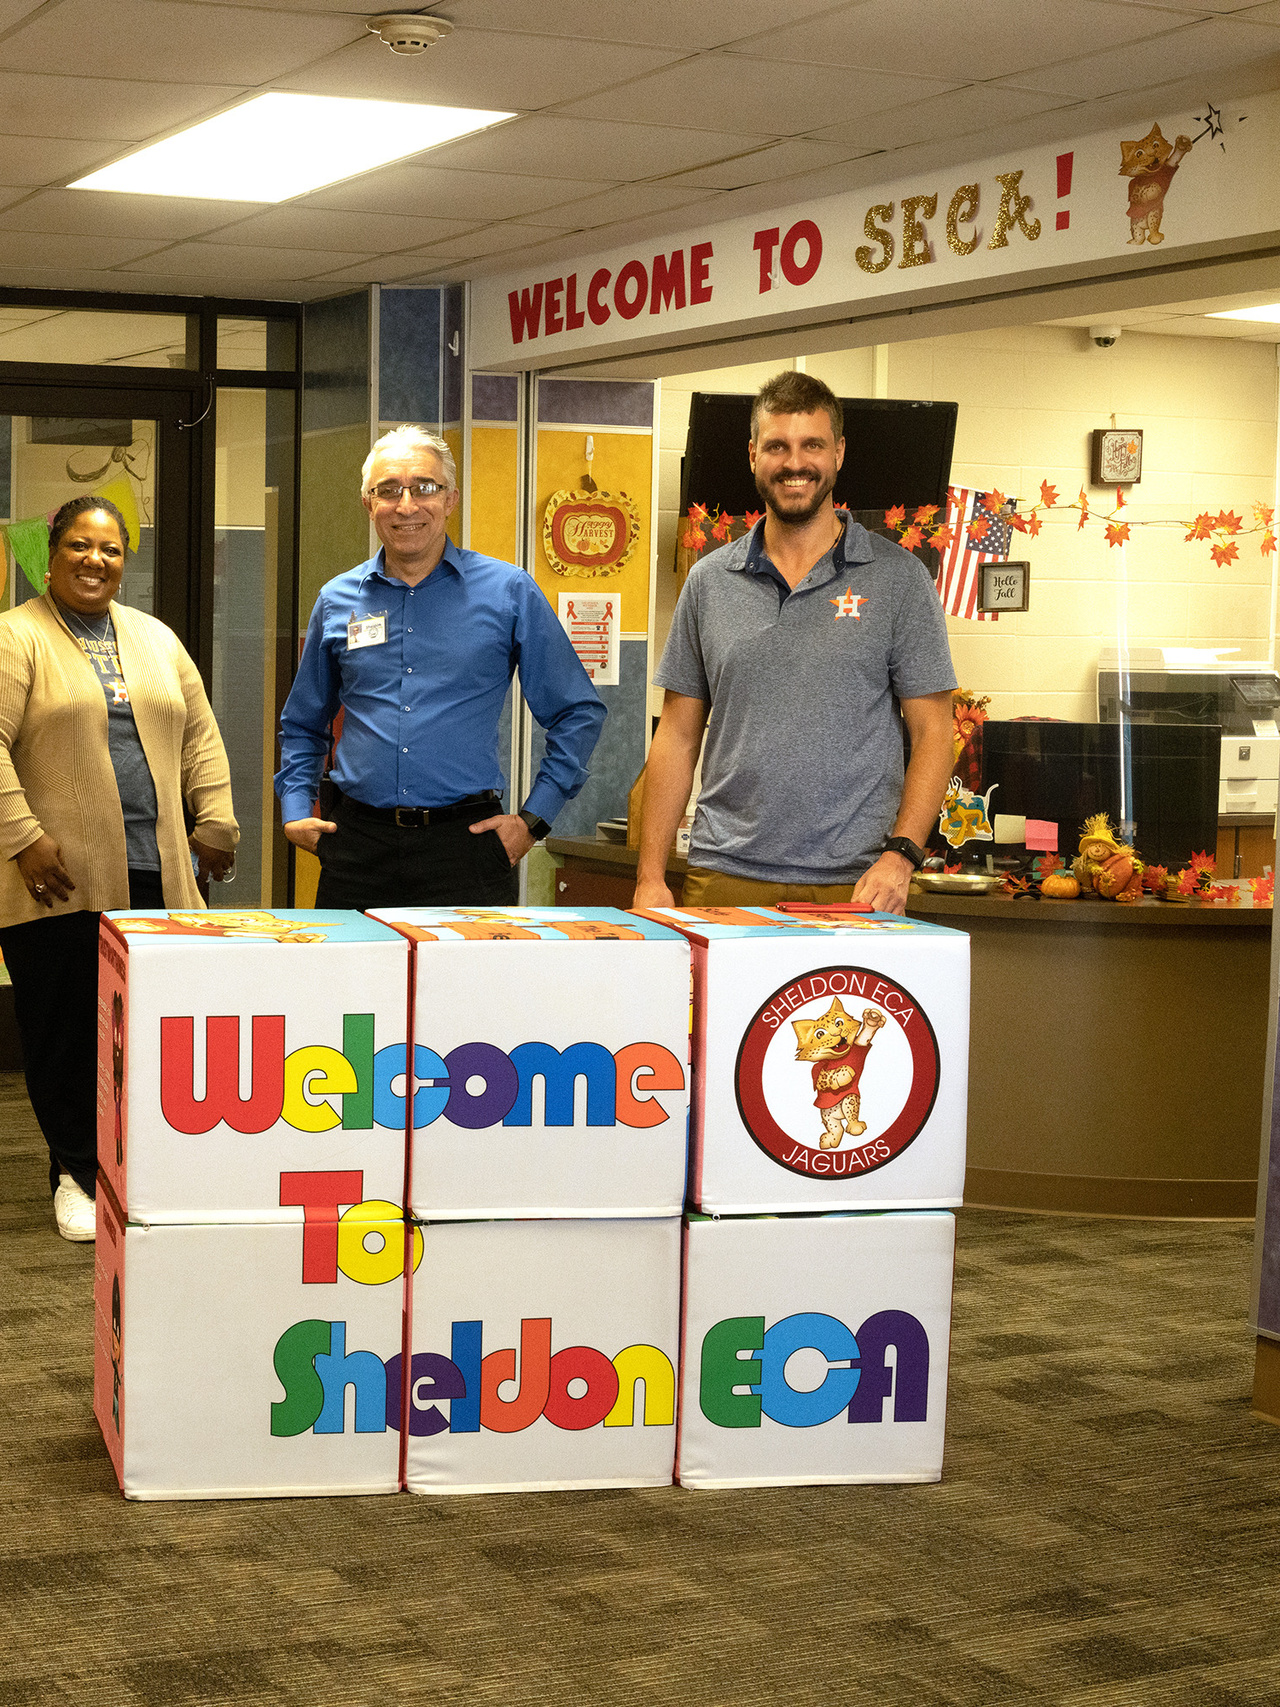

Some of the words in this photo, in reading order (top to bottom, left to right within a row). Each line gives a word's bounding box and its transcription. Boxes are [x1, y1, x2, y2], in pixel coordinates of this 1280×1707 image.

[507, 241, 714, 345] WELCOME
[752, 219, 823, 295] TO
[854, 151, 1074, 275] SECA!
[993, 575, 1019, 588] Hello
[993, 588, 1017, 601] Fall
[762, 973, 867, 1029] SHELDON
[870, 981, 915, 1028] ECA
[160, 1012, 686, 1136] Welcome
[781, 1138, 891, 1174] JAGUARS
[278, 1169, 425, 1286] To
[270, 1317, 675, 1438] Sheldon
[698, 1309, 931, 1429] ECA
